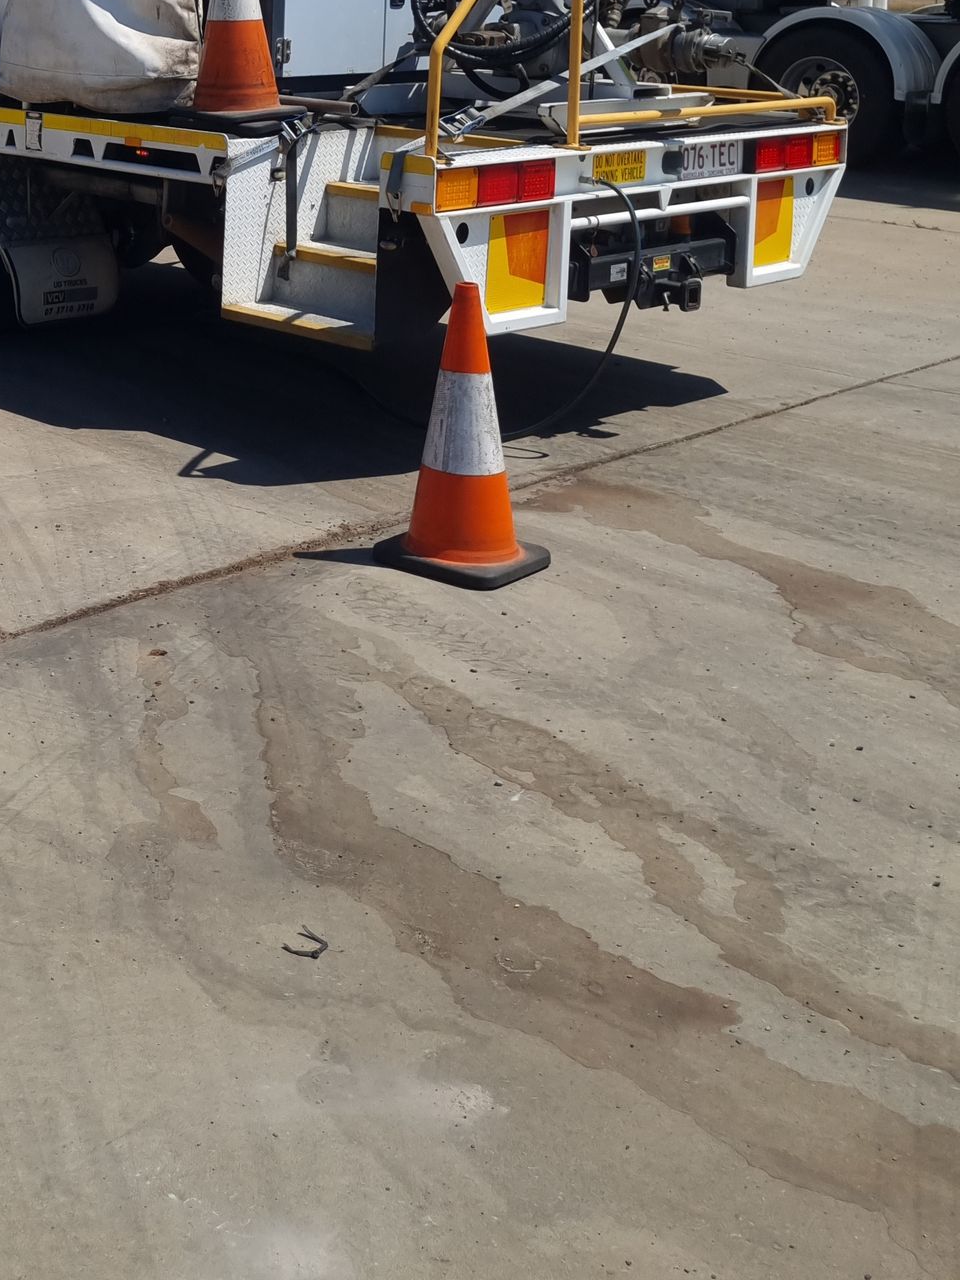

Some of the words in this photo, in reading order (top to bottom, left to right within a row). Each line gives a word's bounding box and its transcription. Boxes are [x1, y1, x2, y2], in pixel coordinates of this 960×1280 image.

[595, 155, 603, 169] DO
[605, 153, 616, 167] NOT
[617, 150, 644, 166] OVERTAKE
[621, 166, 643, 181] VEHICLE
